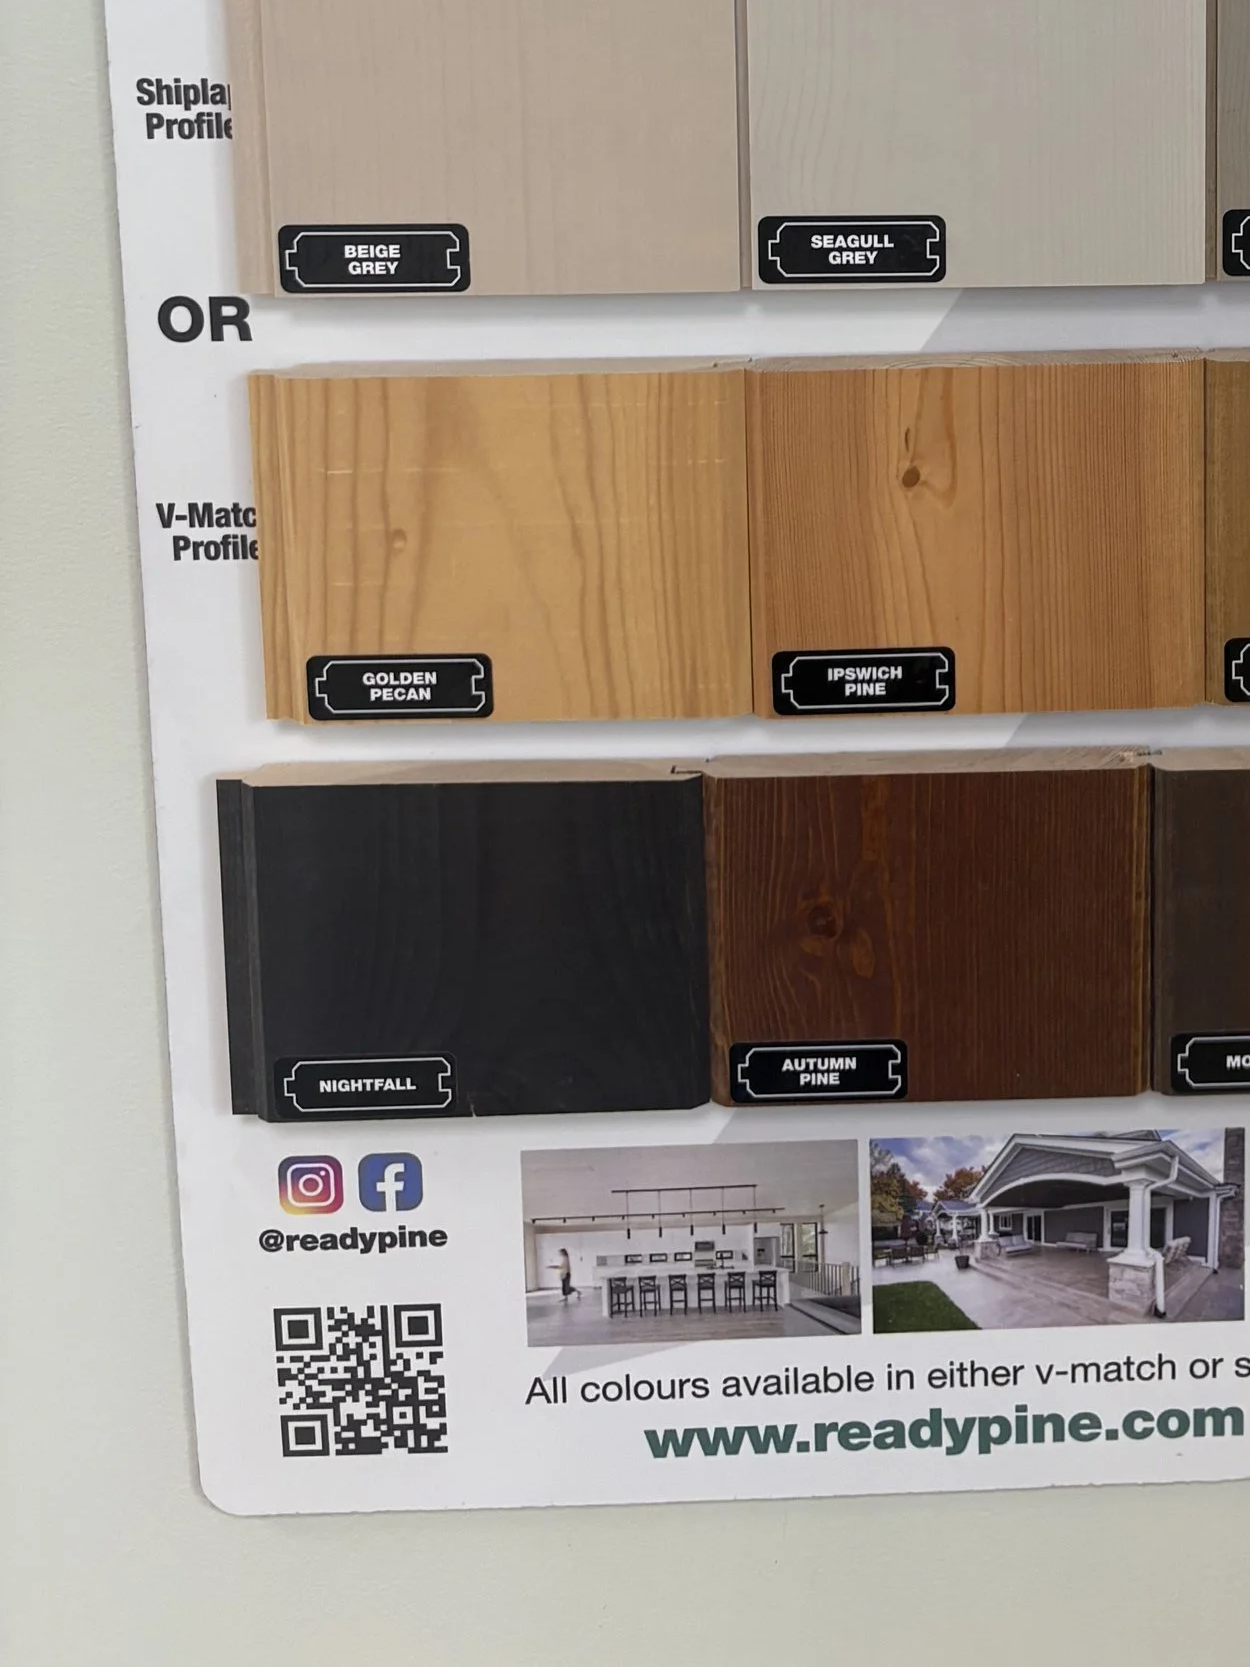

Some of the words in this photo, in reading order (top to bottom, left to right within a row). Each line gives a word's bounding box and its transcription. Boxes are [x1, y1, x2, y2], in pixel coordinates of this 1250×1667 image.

[136, 77, 231, 111] Shipla
[810, 234, 895, 249] SEAGULL
[344, 244, 401, 259] BEIGE
[828, 250, 878, 265] GREY
[347, 261, 399, 275] GREY
[157, 295, 253, 343] OR
[155, 502, 257, 529] V-Matc
[362, 671, 437, 686] GOLDEN
[827, 666, 903, 682] IPSWICH
[369, 687, 432, 702] PECAN
[844, 682, 887, 697] PINE
[781, 1056, 857, 1072] AUTUMN
[318, 1077, 417, 1093] NIGHTFALL
[799, 1072, 841, 1086] PINE
[258, 1225, 448, 1254] @readypine
[525, 1375, 568, 1406] All
[580, 1373, 711, 1403] colours
[721, 1365, 875, 1399] available
[886, 1363, 915, 1392] in
[927, 1360, 1024, 1390] either
[1035, 1352, 1176, 1386] v-match
[1189, 1354, 1224, 1381] or
[643, 1403, 1245, 1459] www.readypine.com
